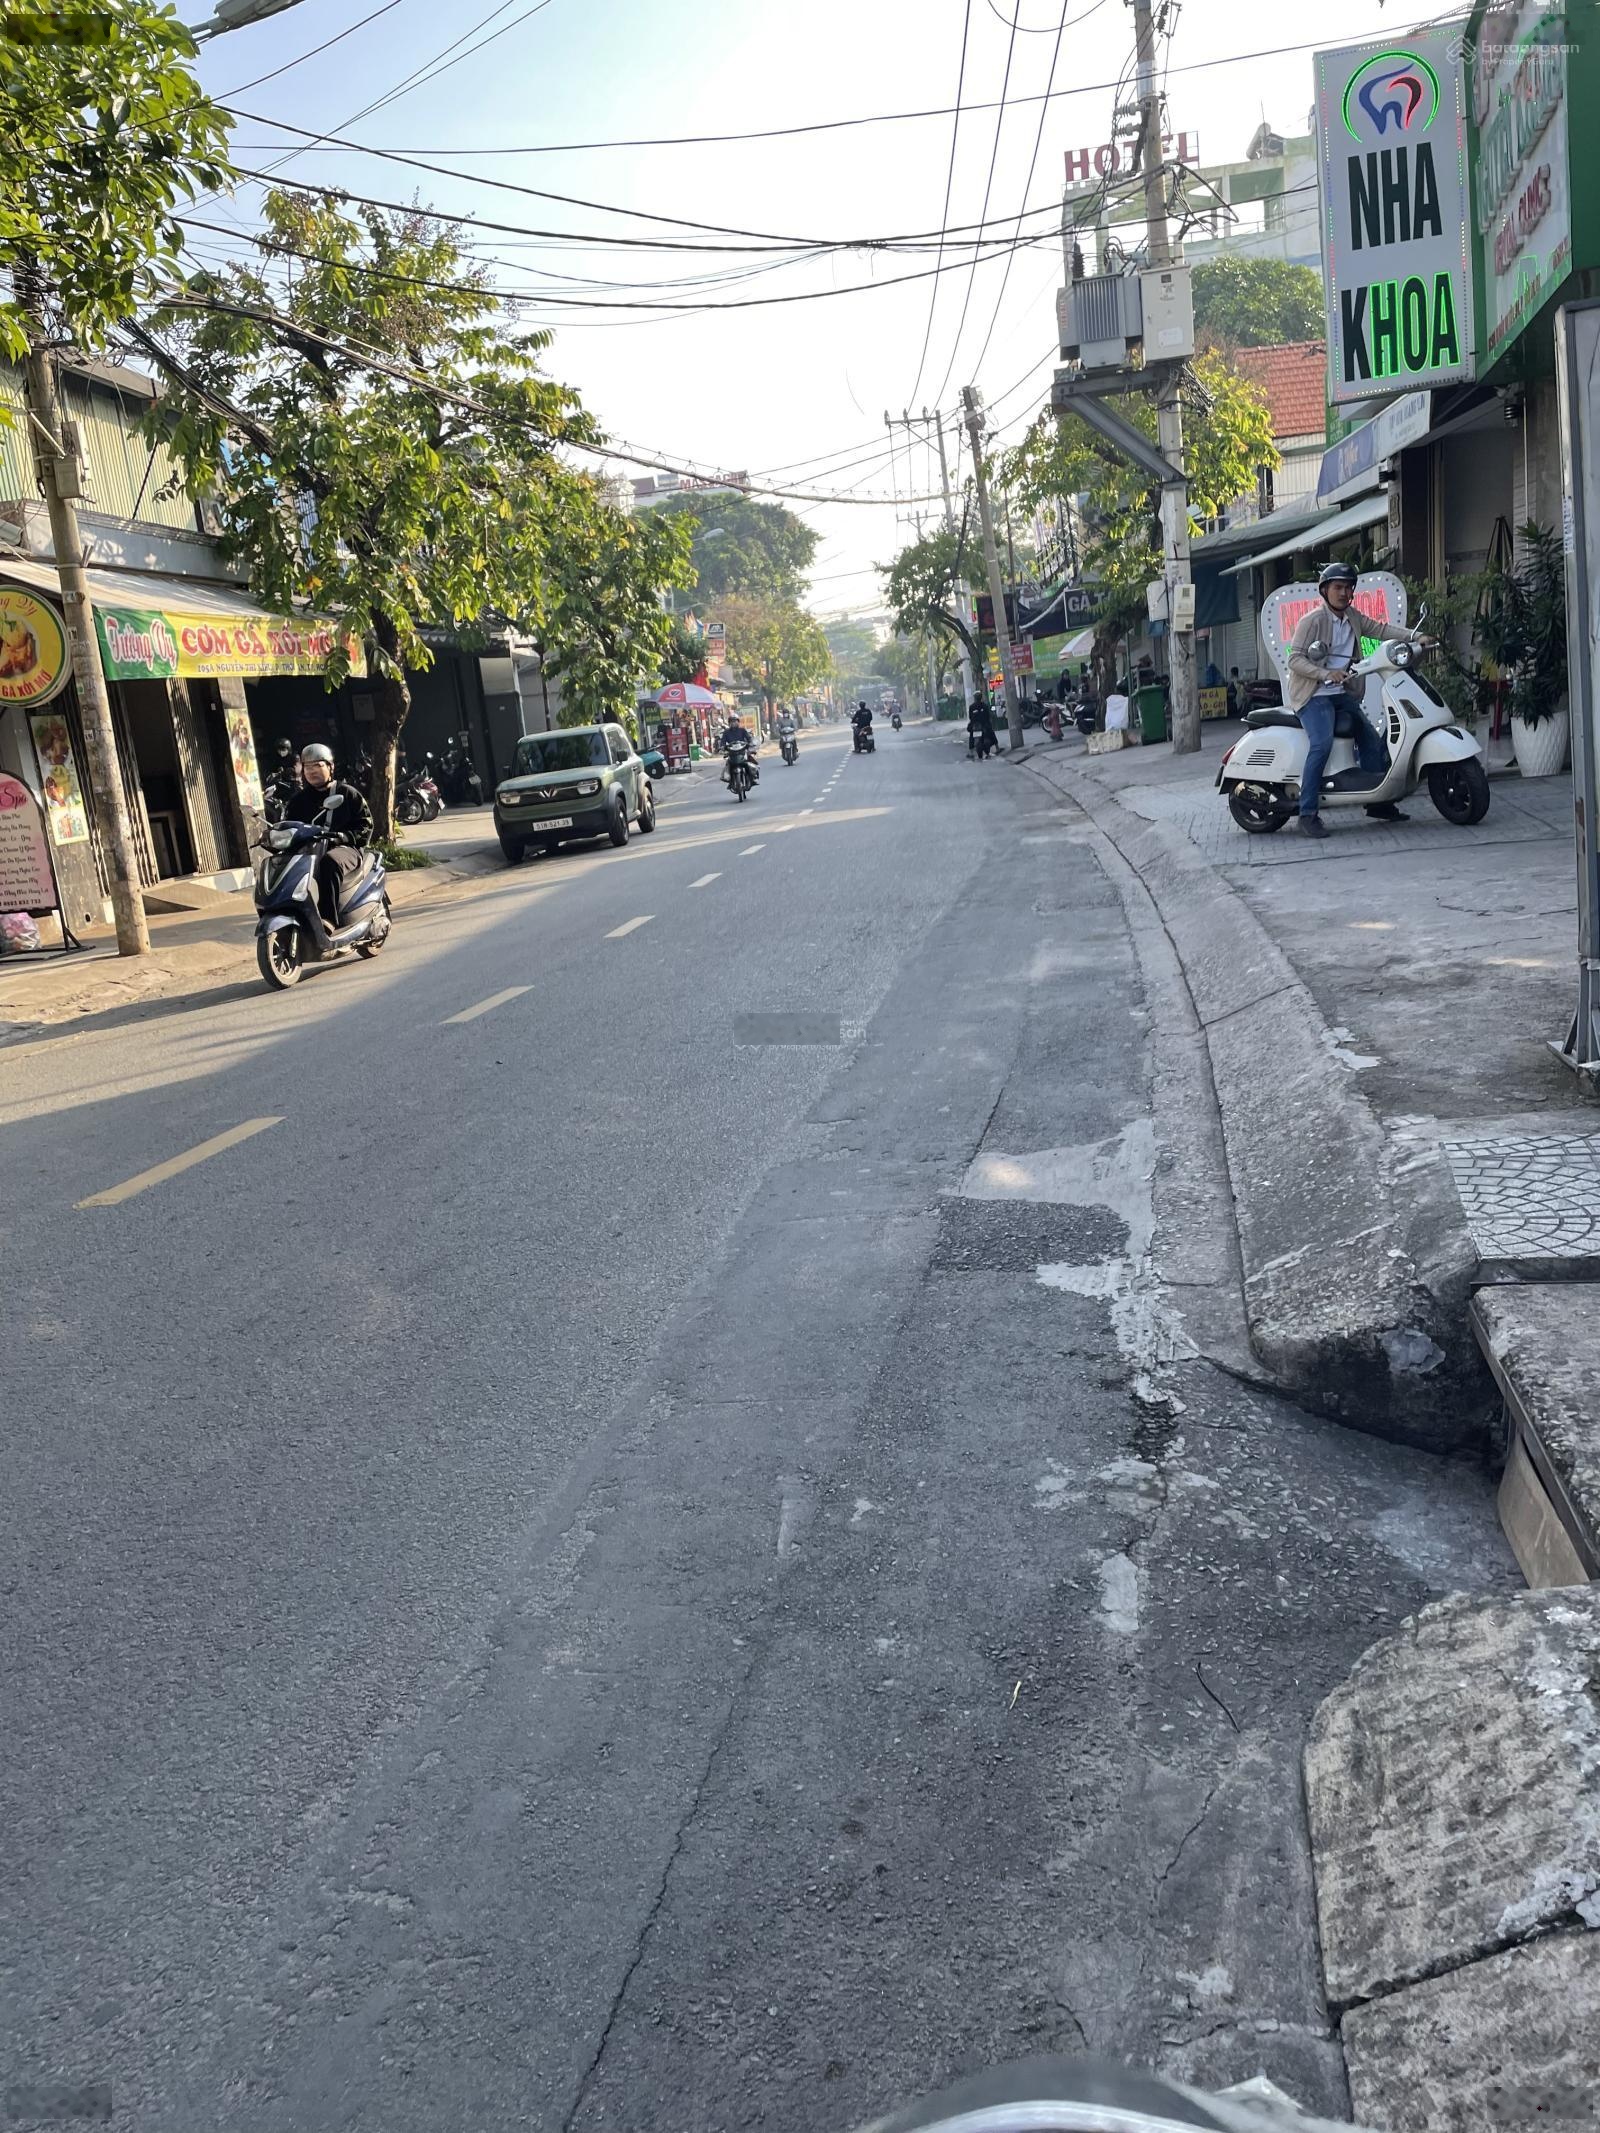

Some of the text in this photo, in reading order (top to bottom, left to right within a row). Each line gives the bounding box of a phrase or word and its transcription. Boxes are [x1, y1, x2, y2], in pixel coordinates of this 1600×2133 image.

[1347, 141, 1443, 251] NHA
[1340, 271, 1461, 383] KHOA
[182, 624, 232, 655] CƠM
[233, 622, 266, 655] GÀ
